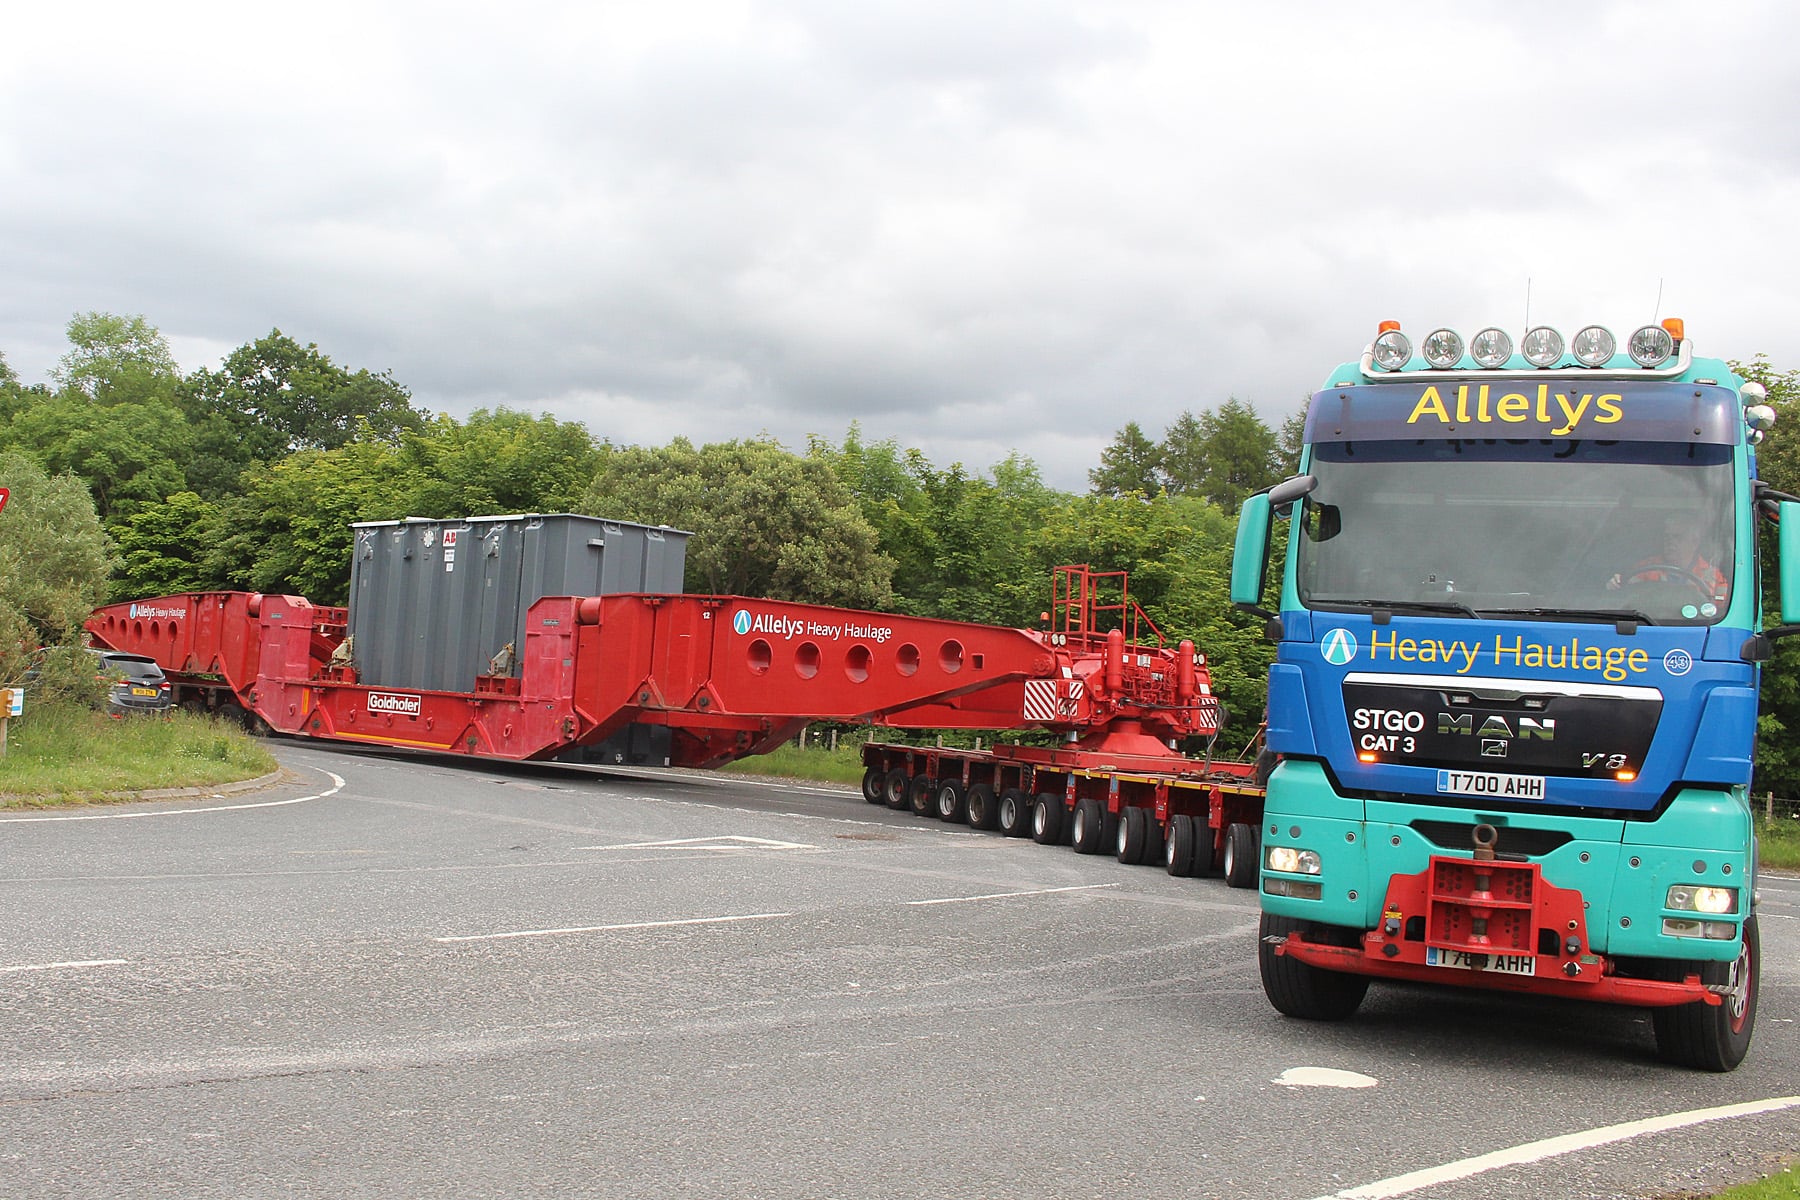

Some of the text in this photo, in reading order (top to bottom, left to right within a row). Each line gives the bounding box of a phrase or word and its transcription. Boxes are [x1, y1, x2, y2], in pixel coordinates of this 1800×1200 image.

[1406, 384, 1624, 436] Allelys
[136, 605, 187, 620] Allelys Heavy Haulage
[702, 611, 711, 620] 12
[752, 613, 892, 643] Allelys Heavy Haulage
[1370, 629, 1649, 682] Heavy Haulage
[1666, 655, 1689, 669] 43
[370, 694, 419, 712] Goldhofer
[1353, 708, 1425, 733] STGO
[1437, 712, 1556, 741] MAN
[1360, 734, 1416, 753] CAT 3
[1581, 752, 1628, 770] V8
[1450, 773, 1542, 797] T700 AHH
[1494, 954, 1533, 973] AHH
